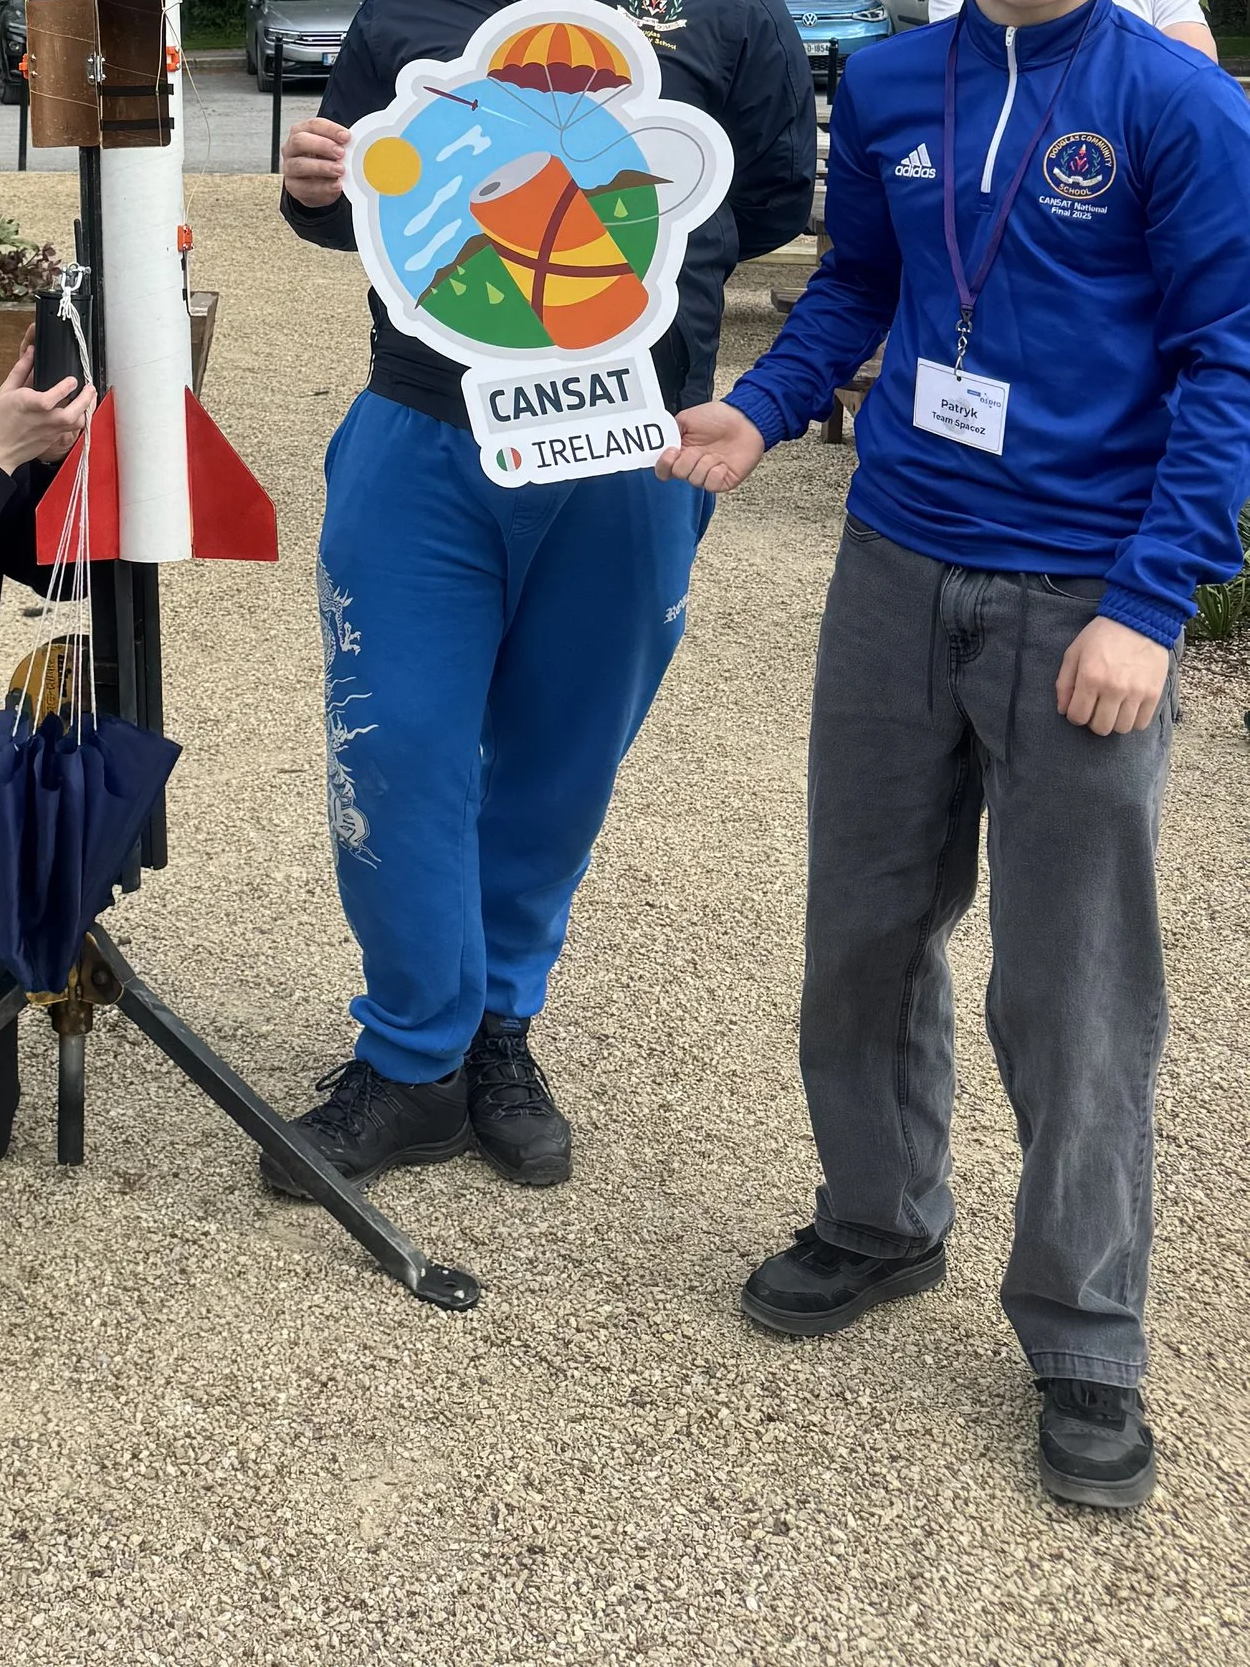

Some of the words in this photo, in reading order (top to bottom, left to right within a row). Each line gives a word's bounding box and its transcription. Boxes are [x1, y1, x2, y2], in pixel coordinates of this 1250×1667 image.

[1049, 135, 1080, 159] DOUGLAS
[1081, 135, 1112, 167] COMMUNITY
[895, 164, 936, 179] adidas
[1058, 183, 1092, 196] SCHOOL
[1039, 195, 1072, 208] CANSAT
[1074, 202, 1108, 214] National
[1051, 207, 1071, 217] Final
[1072, 210, 1092, 220] 2025
[489, 368, 630, 422] CANSAT
[932, 411, 953, 425] Team
[941, 399, 977, 419] Patryk
[532, 423, 665, 468] IRELAND
